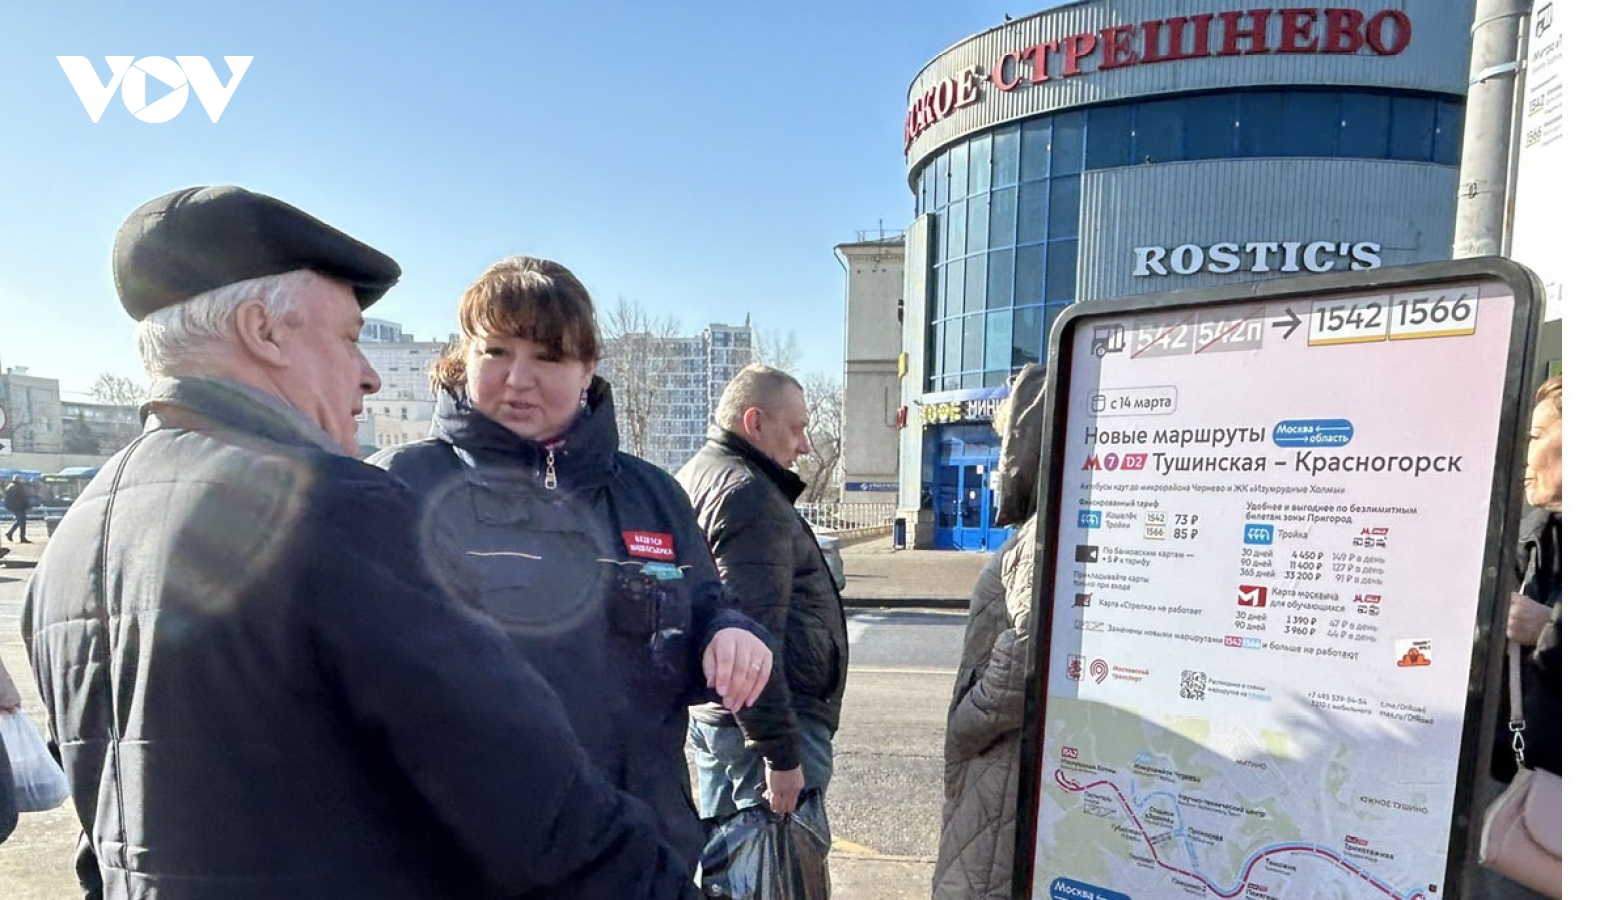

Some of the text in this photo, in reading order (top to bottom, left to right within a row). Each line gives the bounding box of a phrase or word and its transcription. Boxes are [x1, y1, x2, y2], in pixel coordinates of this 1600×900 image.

[1133, 241, 1382, 276] ROSTIC'S
[1137, 323, 1188, 350] 542
[1317, 302, 1382, 332] 1542
[1398, 294, 1471, 326] 1566
[1120, 396, 1131, 409] 14
[1134, 397, 1172, 411] марта
[1276, 425, 1314, 435] Москва
[1084, 427, 1266, 448] Новые маршруты
[1309, 433, 1350, 443] область
[1153, 453, 1267, 476] Тушинская
[1295, 451, 1463, 477] Красногорск
[1137, 500, 1159, 508] тариф
[1246, 502, 1282, 511] Удобнее
[1292, 505, 1334, 513] выгоднее
[1336, 505, 1347, 513] по
[1350, 505, 1417, 514] безлимитным
[1147, 514, 1165, 523] 1542
[1175, 514, 1188, 525] 73
[1246, 513, 1281, 521] билетам
[1306, 514, 1352, 524] Пригород
[1146, 527, 1164, 536] 1566
[1173, 528, 1188, 539] 85
[1278, 529, 1308, 539] Тройка
[1299, 552, 1316, 560] 450
[1240, 559, 1252, 567] 90
[1297, 562, 1314, 570] 400
[1240, 568, 1255, 577] 365
[1297, 572, 1314, 580] 200
[1271, 587, 1296, 597] Карта
[1270, 600, 1286, 608] для
[1235, 611, 1247, 619] 30
[1292, 616, 1310, 625] 390
[1235, 621, 1246, 629] 90
[1270, 641, 1302, 654] больше
[1304, 646, 1314, 655] не
[1054, 881, 1095, 900] Москва
